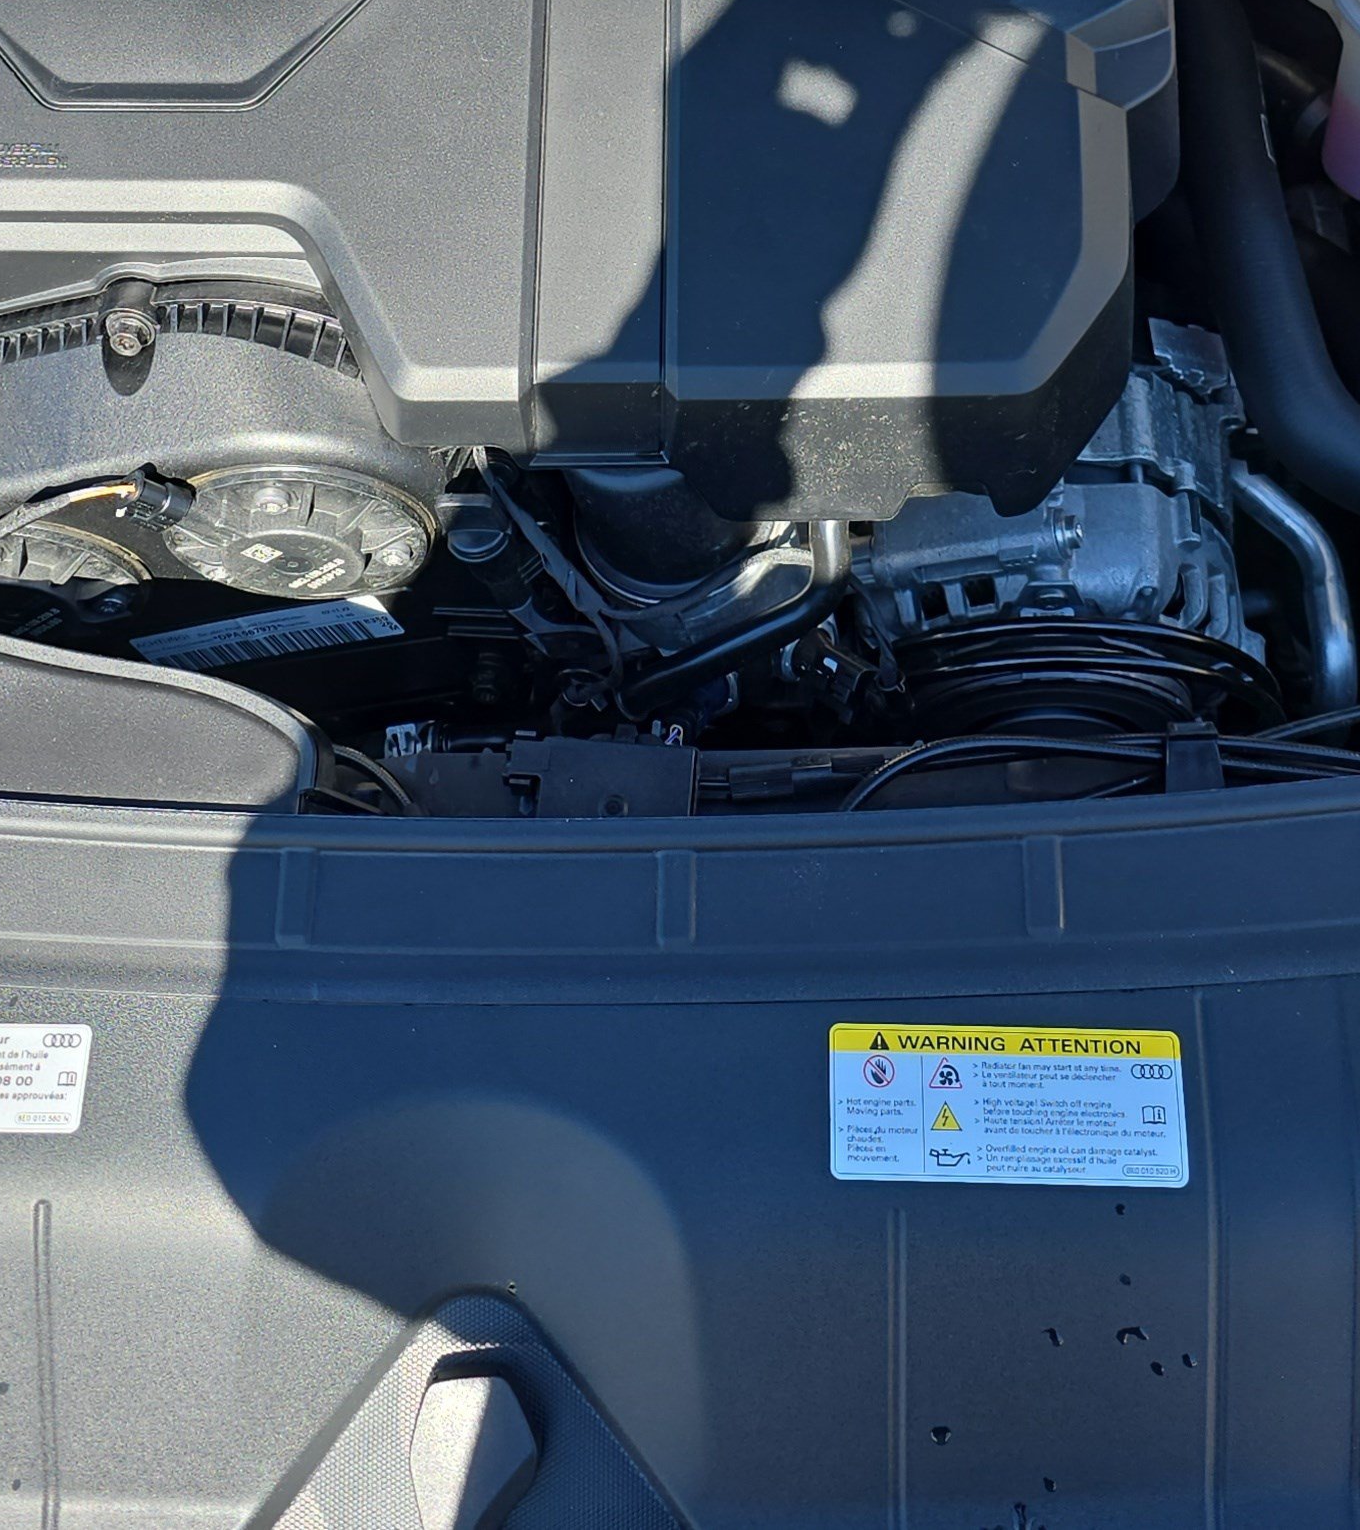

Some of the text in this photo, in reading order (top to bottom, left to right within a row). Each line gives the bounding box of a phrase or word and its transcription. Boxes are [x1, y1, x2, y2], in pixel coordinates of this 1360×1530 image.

[897, 1035, 1141, 1055] WARNING ATTENTION
[7, 1049, 19, 1059] de
[981, 1062, 1016, 1070] Radiator
[1018, 1063, 1031, 1071] fan
[1033, 1064, 1051, 1072] may
[1052, 1064, 1073, 1072] start
[1084, 1065, 1099, 1074] any
[15, 1075, 33, 1086] 00
[1039, 1072, 1058, 1081] peut
[846, 1097, 862, 1106] Hot
[863, 1099, 892, 1108] engine
[982, 1098, 1002, 1107] High
[1040, 1099, 1068, 1108] Switch
[1070, 1099, 1082, 1108] off
[1083, 1101, 1112, 1110] engine
[846, 1107, 878, 1117] Moving
[983, 1108, 1010, 1116] before
[1011, 1108, 1048, 1119] touching
[1050, 1109, 1078, 1119] engine
[983, 1116, 1009, 1125] Haute
[1076, 1118, 1085, 1126] le
[1086, 1119, 1116, 1127] moteur
[888, 1127, 918, 1135] moteur
[1008, 1127, 1020, 1135] de
[1021, 1127, 1053, 1136] toucher
[1120, 1129, 1132, 1137] du
[875, 1145, 886, 1153] en
[985, 1144, 1026, 1154] Overfilled
[1027, 1146, 1056, 1156] engine
[1058, 1146, 1070, 1154] oil
[1088, 1147, 1122, 1157] damage
[985, 1154, 999, 1162] Un
[1053, 1156, 1087, 1165] excessif
[986, 1164, 1005, 1173] peut
[1006, 1164, 1029, 1172] nuire
